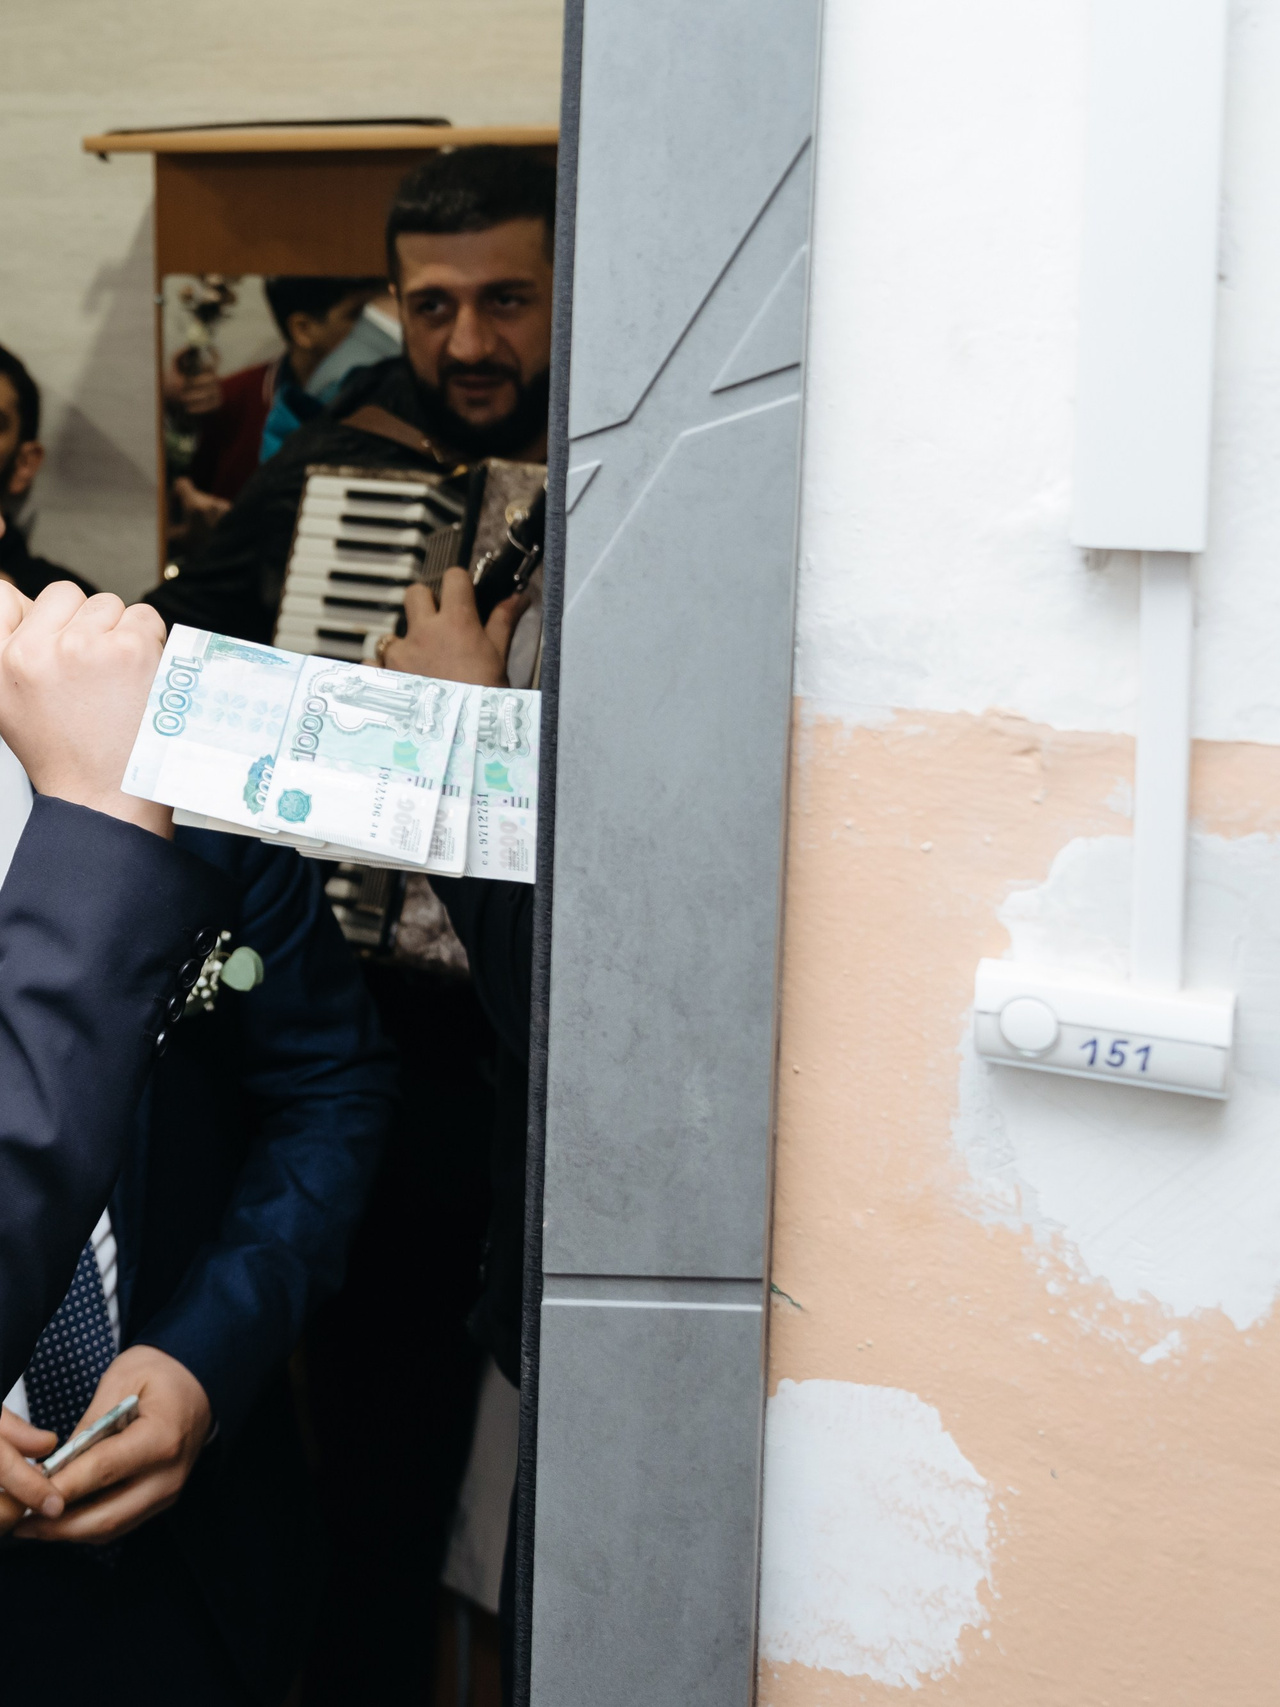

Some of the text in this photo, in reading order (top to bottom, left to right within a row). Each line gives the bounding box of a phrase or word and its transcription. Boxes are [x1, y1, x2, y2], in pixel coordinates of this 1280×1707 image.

[153, 656, 203, 737] 1000
[291, 695, 328, 762] 1000
[1080, 1037, 1151, 1073] 151
